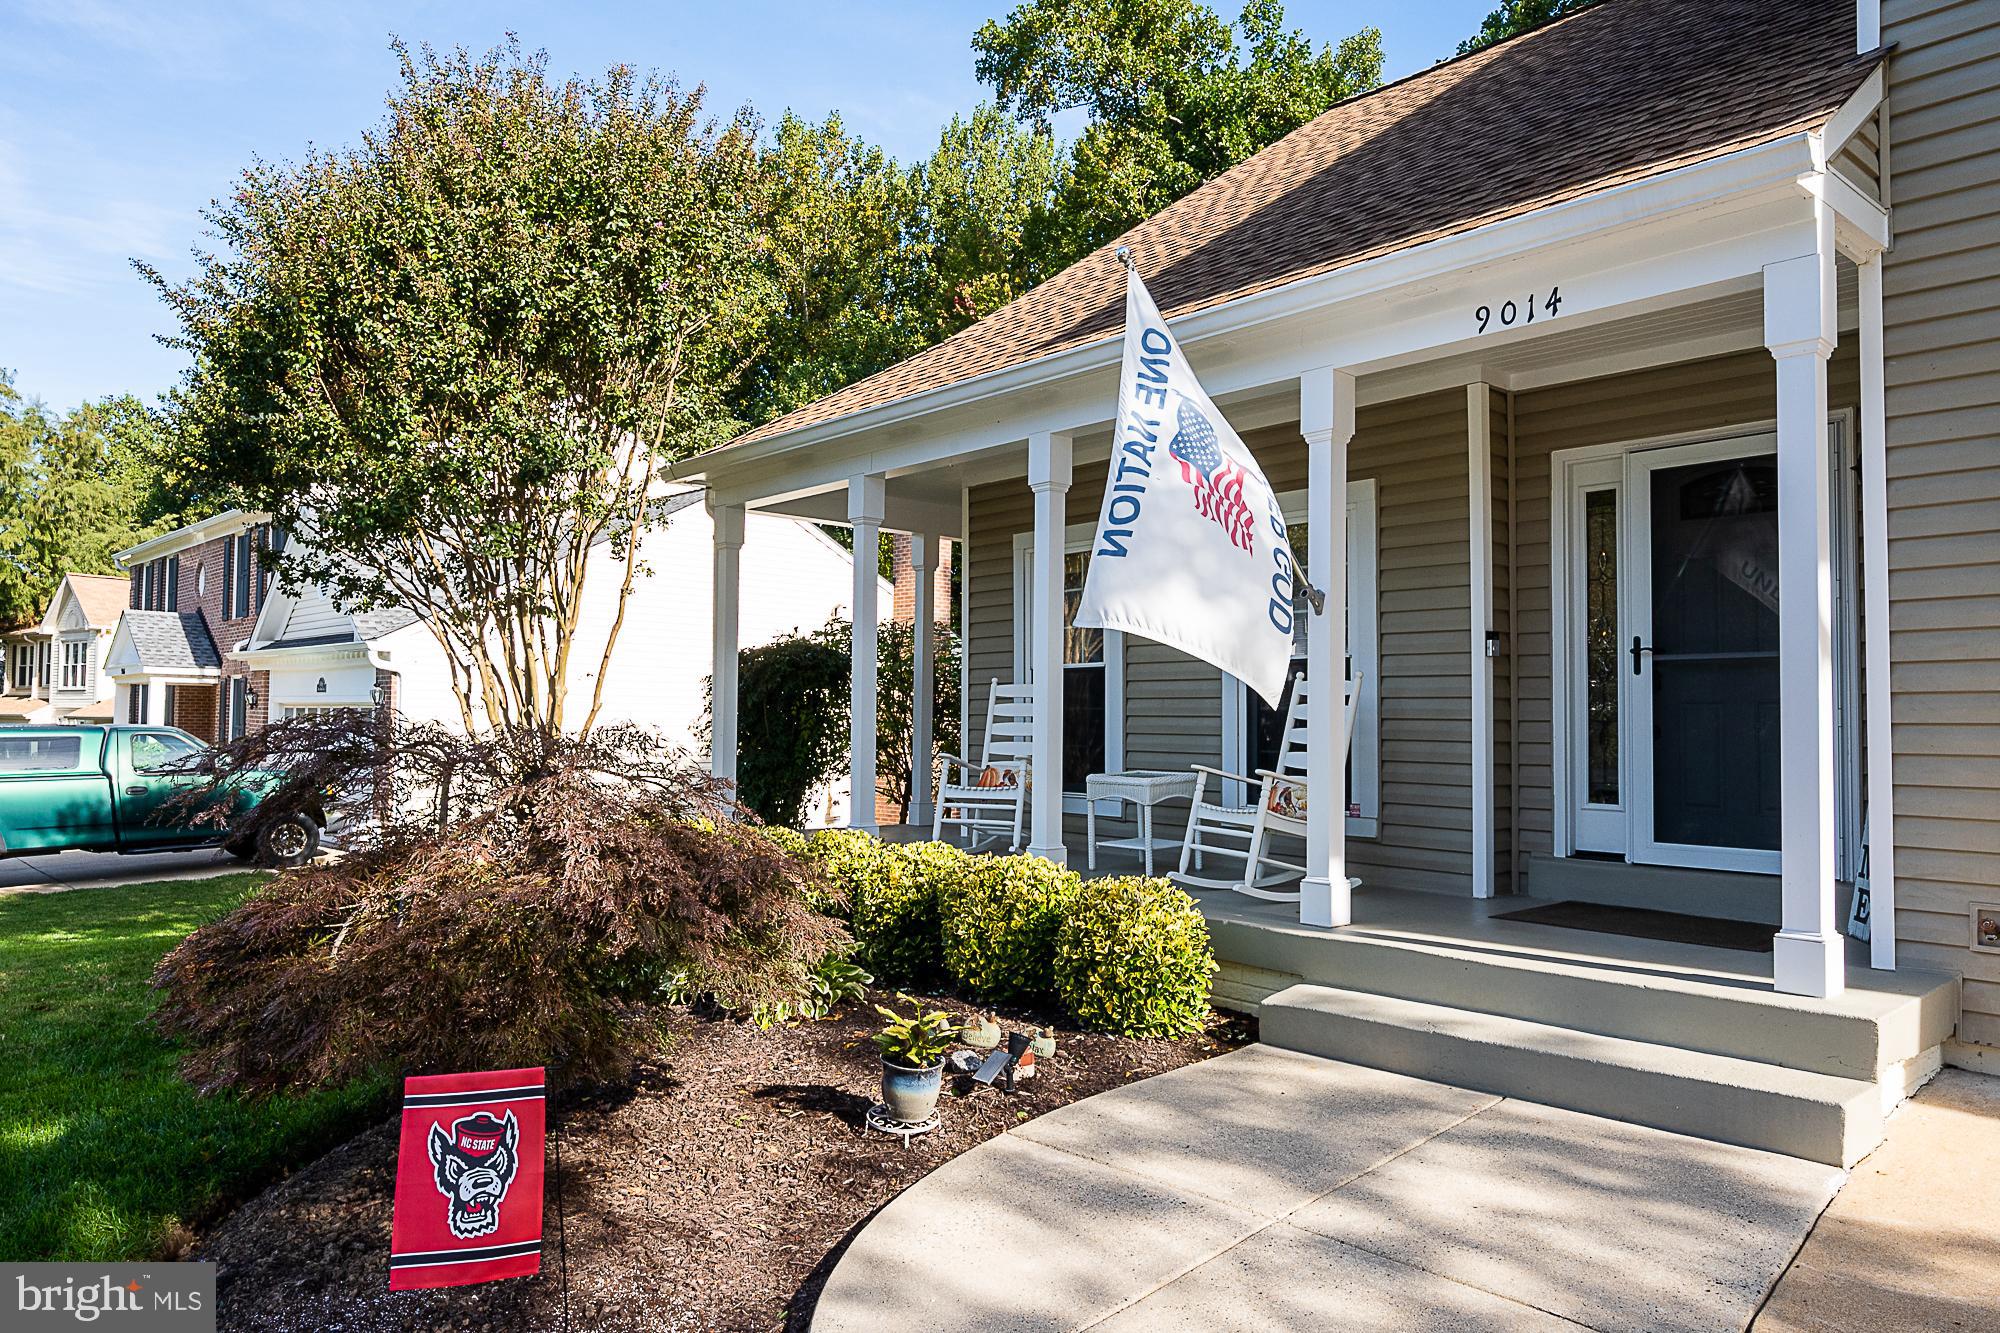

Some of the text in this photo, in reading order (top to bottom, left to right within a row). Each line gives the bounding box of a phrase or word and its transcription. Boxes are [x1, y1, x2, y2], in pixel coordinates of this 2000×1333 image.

[1475, 286, 1562, 334] 9014
[461, 1136, 495, 1150] NC STATE
